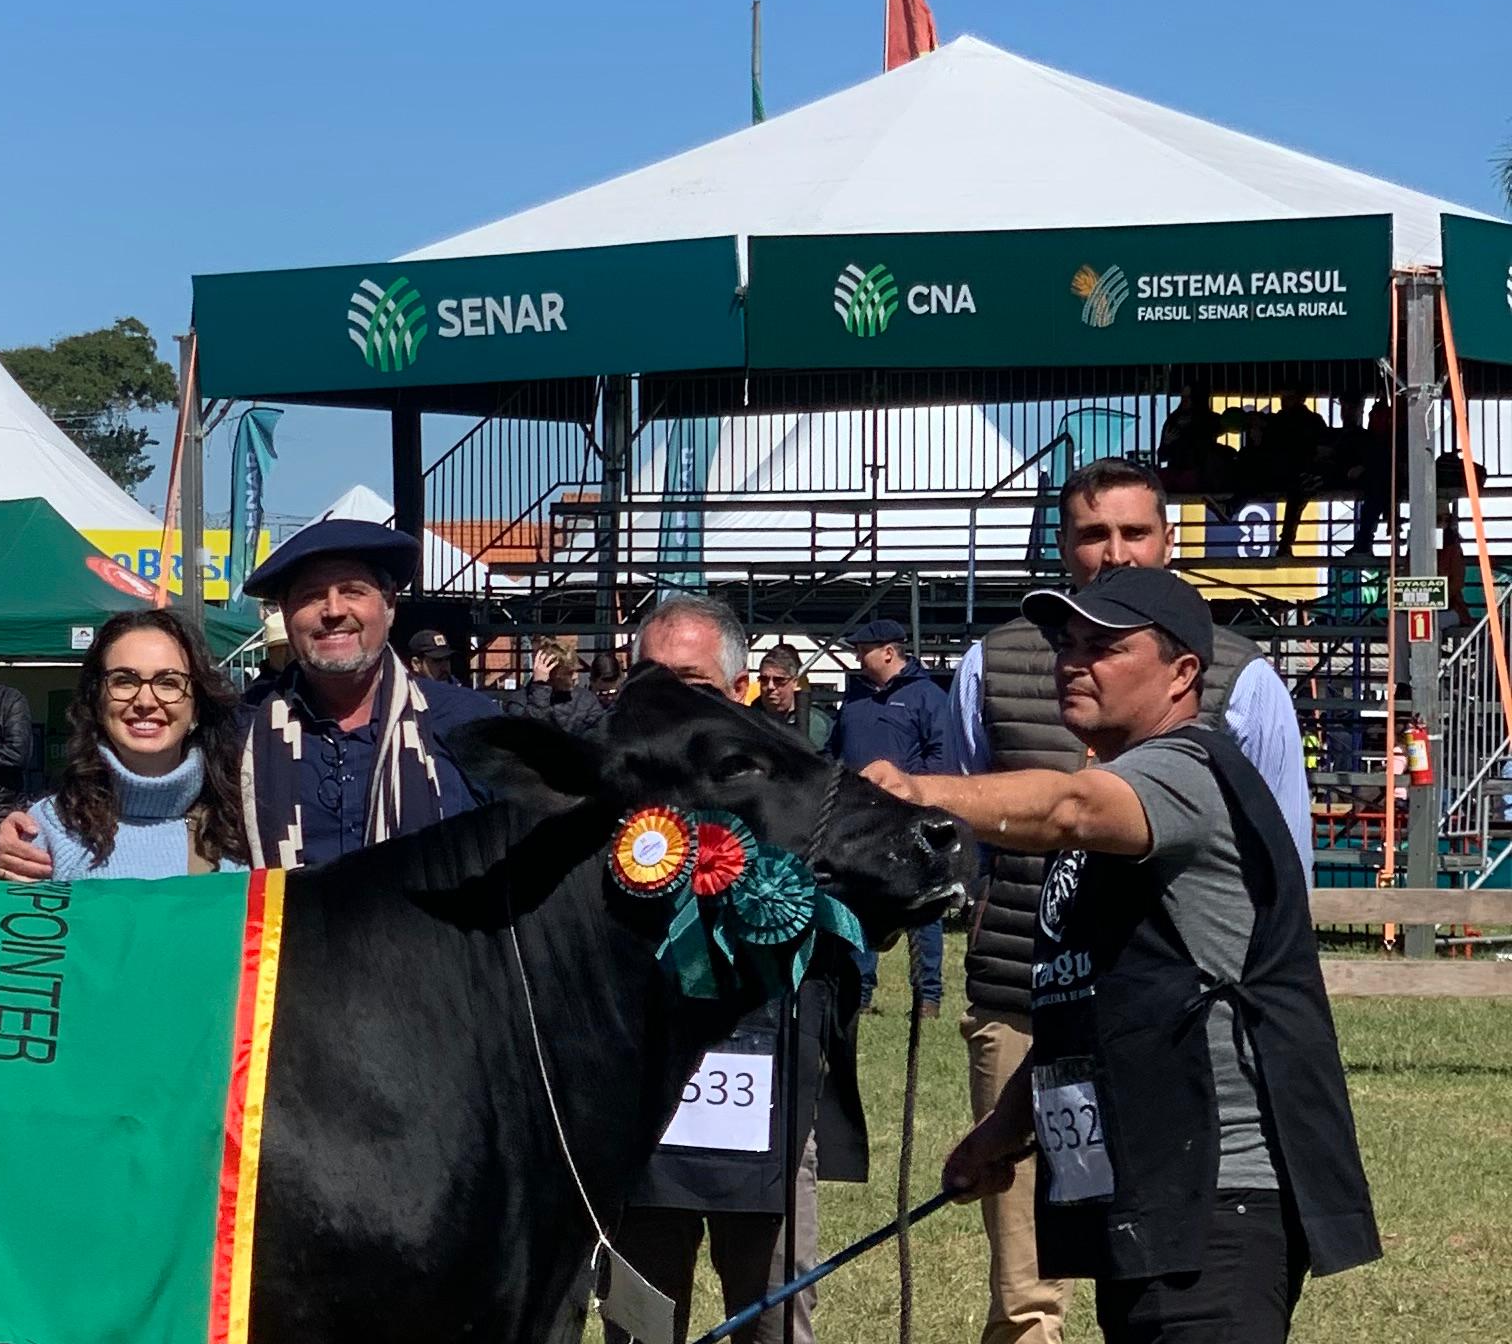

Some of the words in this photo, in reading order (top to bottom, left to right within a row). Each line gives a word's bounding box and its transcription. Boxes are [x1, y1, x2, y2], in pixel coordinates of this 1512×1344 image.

[907, 283, 977, 315] CNA
[1137, 273, 1244, 299] SISTEMA
[1250, 270, 1347, 295] FARSUL
[437, 292, 568, 338] SENAR
[1137, 306, 1192, 321] FARSUL
[1198, 304, 1249, 320] SENAR
[1255, 303, 1296, 318] CASA
[1298, 302, 1348, 317] RURAL
